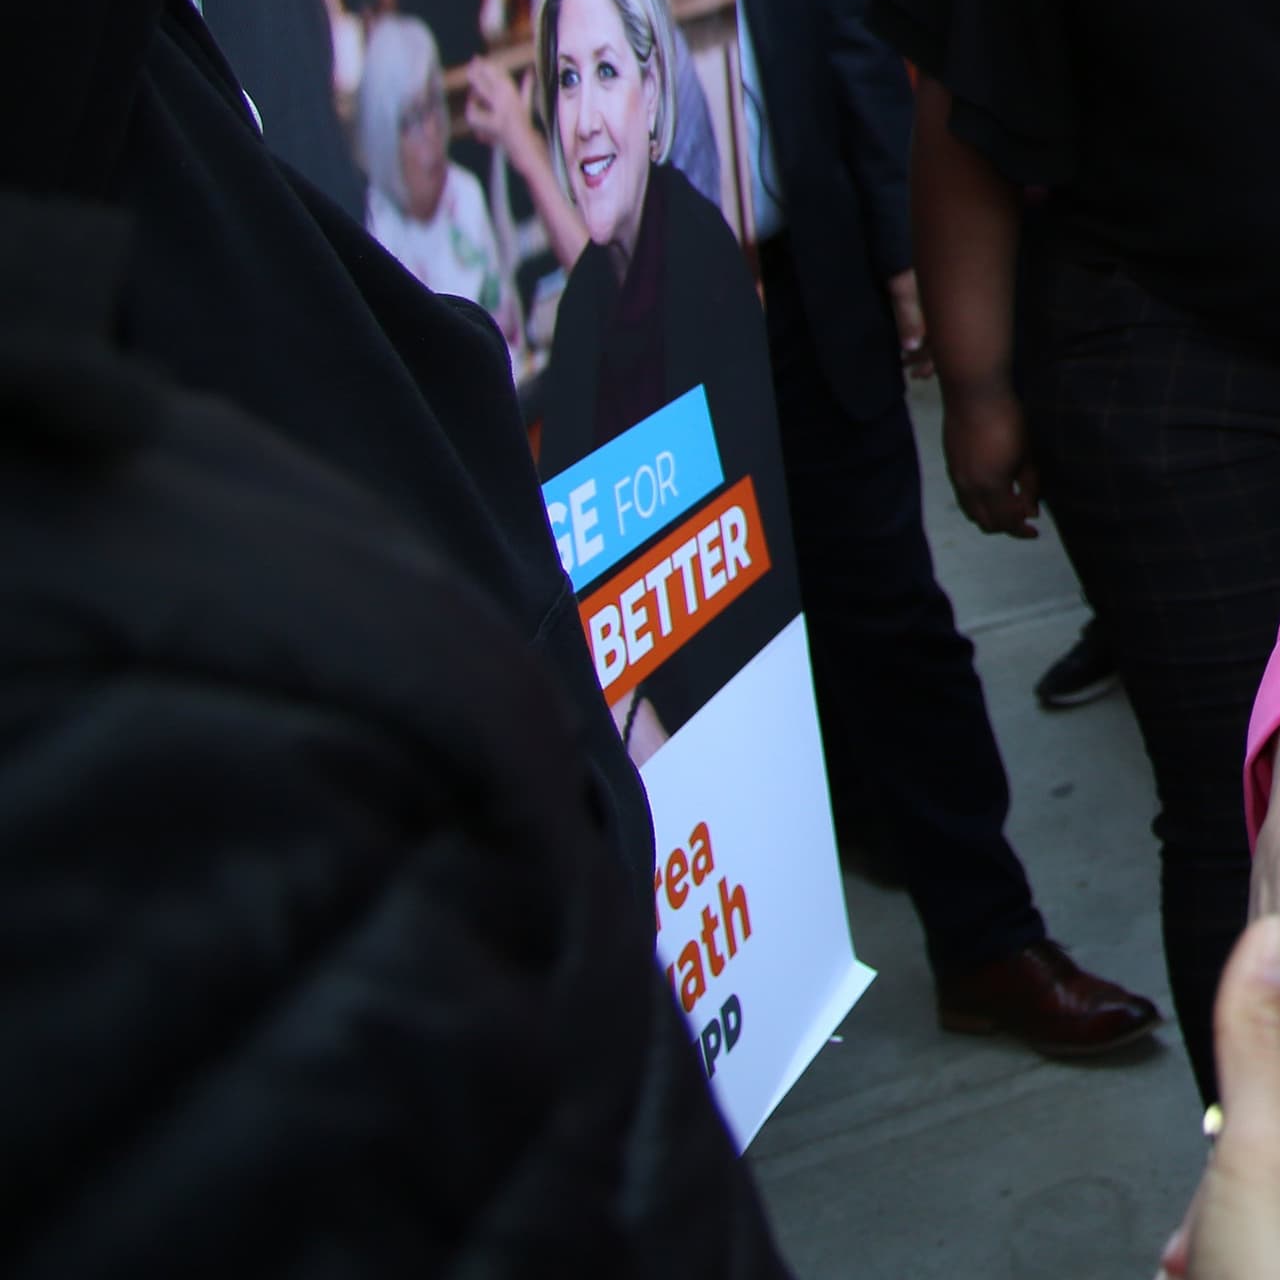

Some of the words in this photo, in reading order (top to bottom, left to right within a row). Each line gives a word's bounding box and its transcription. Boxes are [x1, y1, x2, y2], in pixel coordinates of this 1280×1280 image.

[612, 450, 679, 537] FOR
[588, 504, 752, 690] BETTER
[666, 876, 752, 1014] ath
[694, 993, 743, 1081] PD
